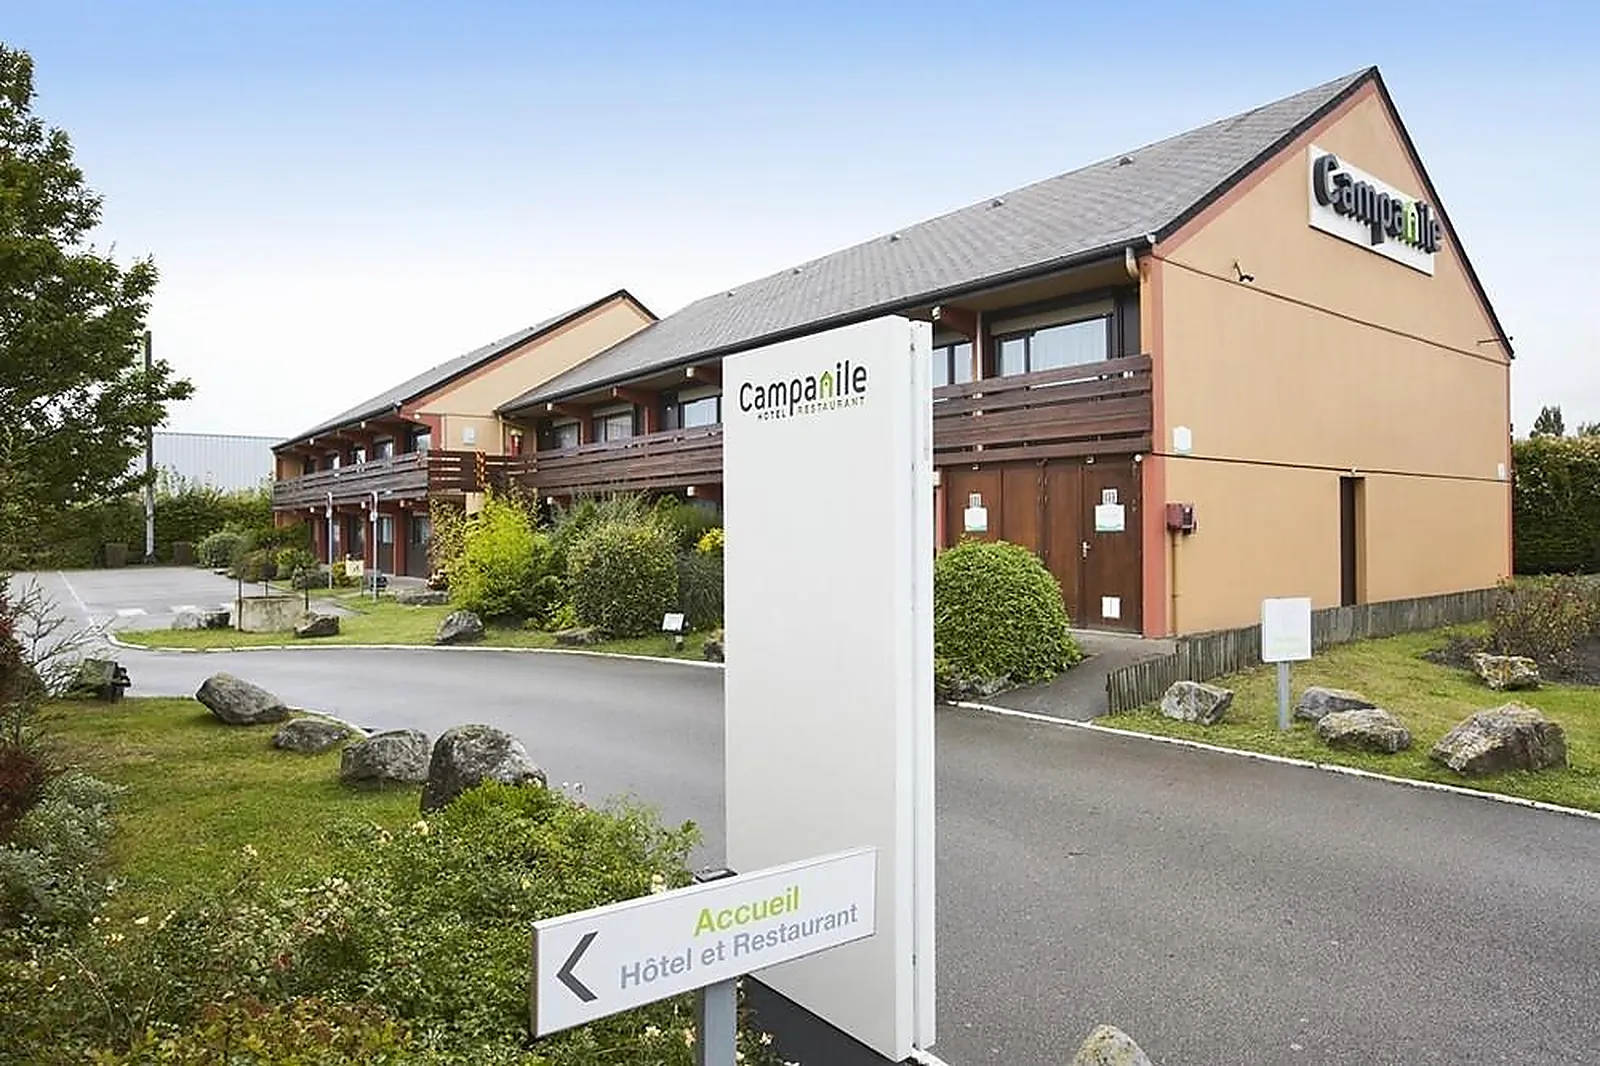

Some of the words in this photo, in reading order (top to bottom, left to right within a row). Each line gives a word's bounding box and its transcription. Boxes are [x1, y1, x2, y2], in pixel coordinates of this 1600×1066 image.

[1313, 154, 1441, 254] Campanile
[739, 360, 867, 417] Campanile
[620, 947, 692, 989] Hôtel
[701, 943, 725, 965] et
[733, 904, 858, 956] Restaurant
[694, 886, 800, 936] Accueil
